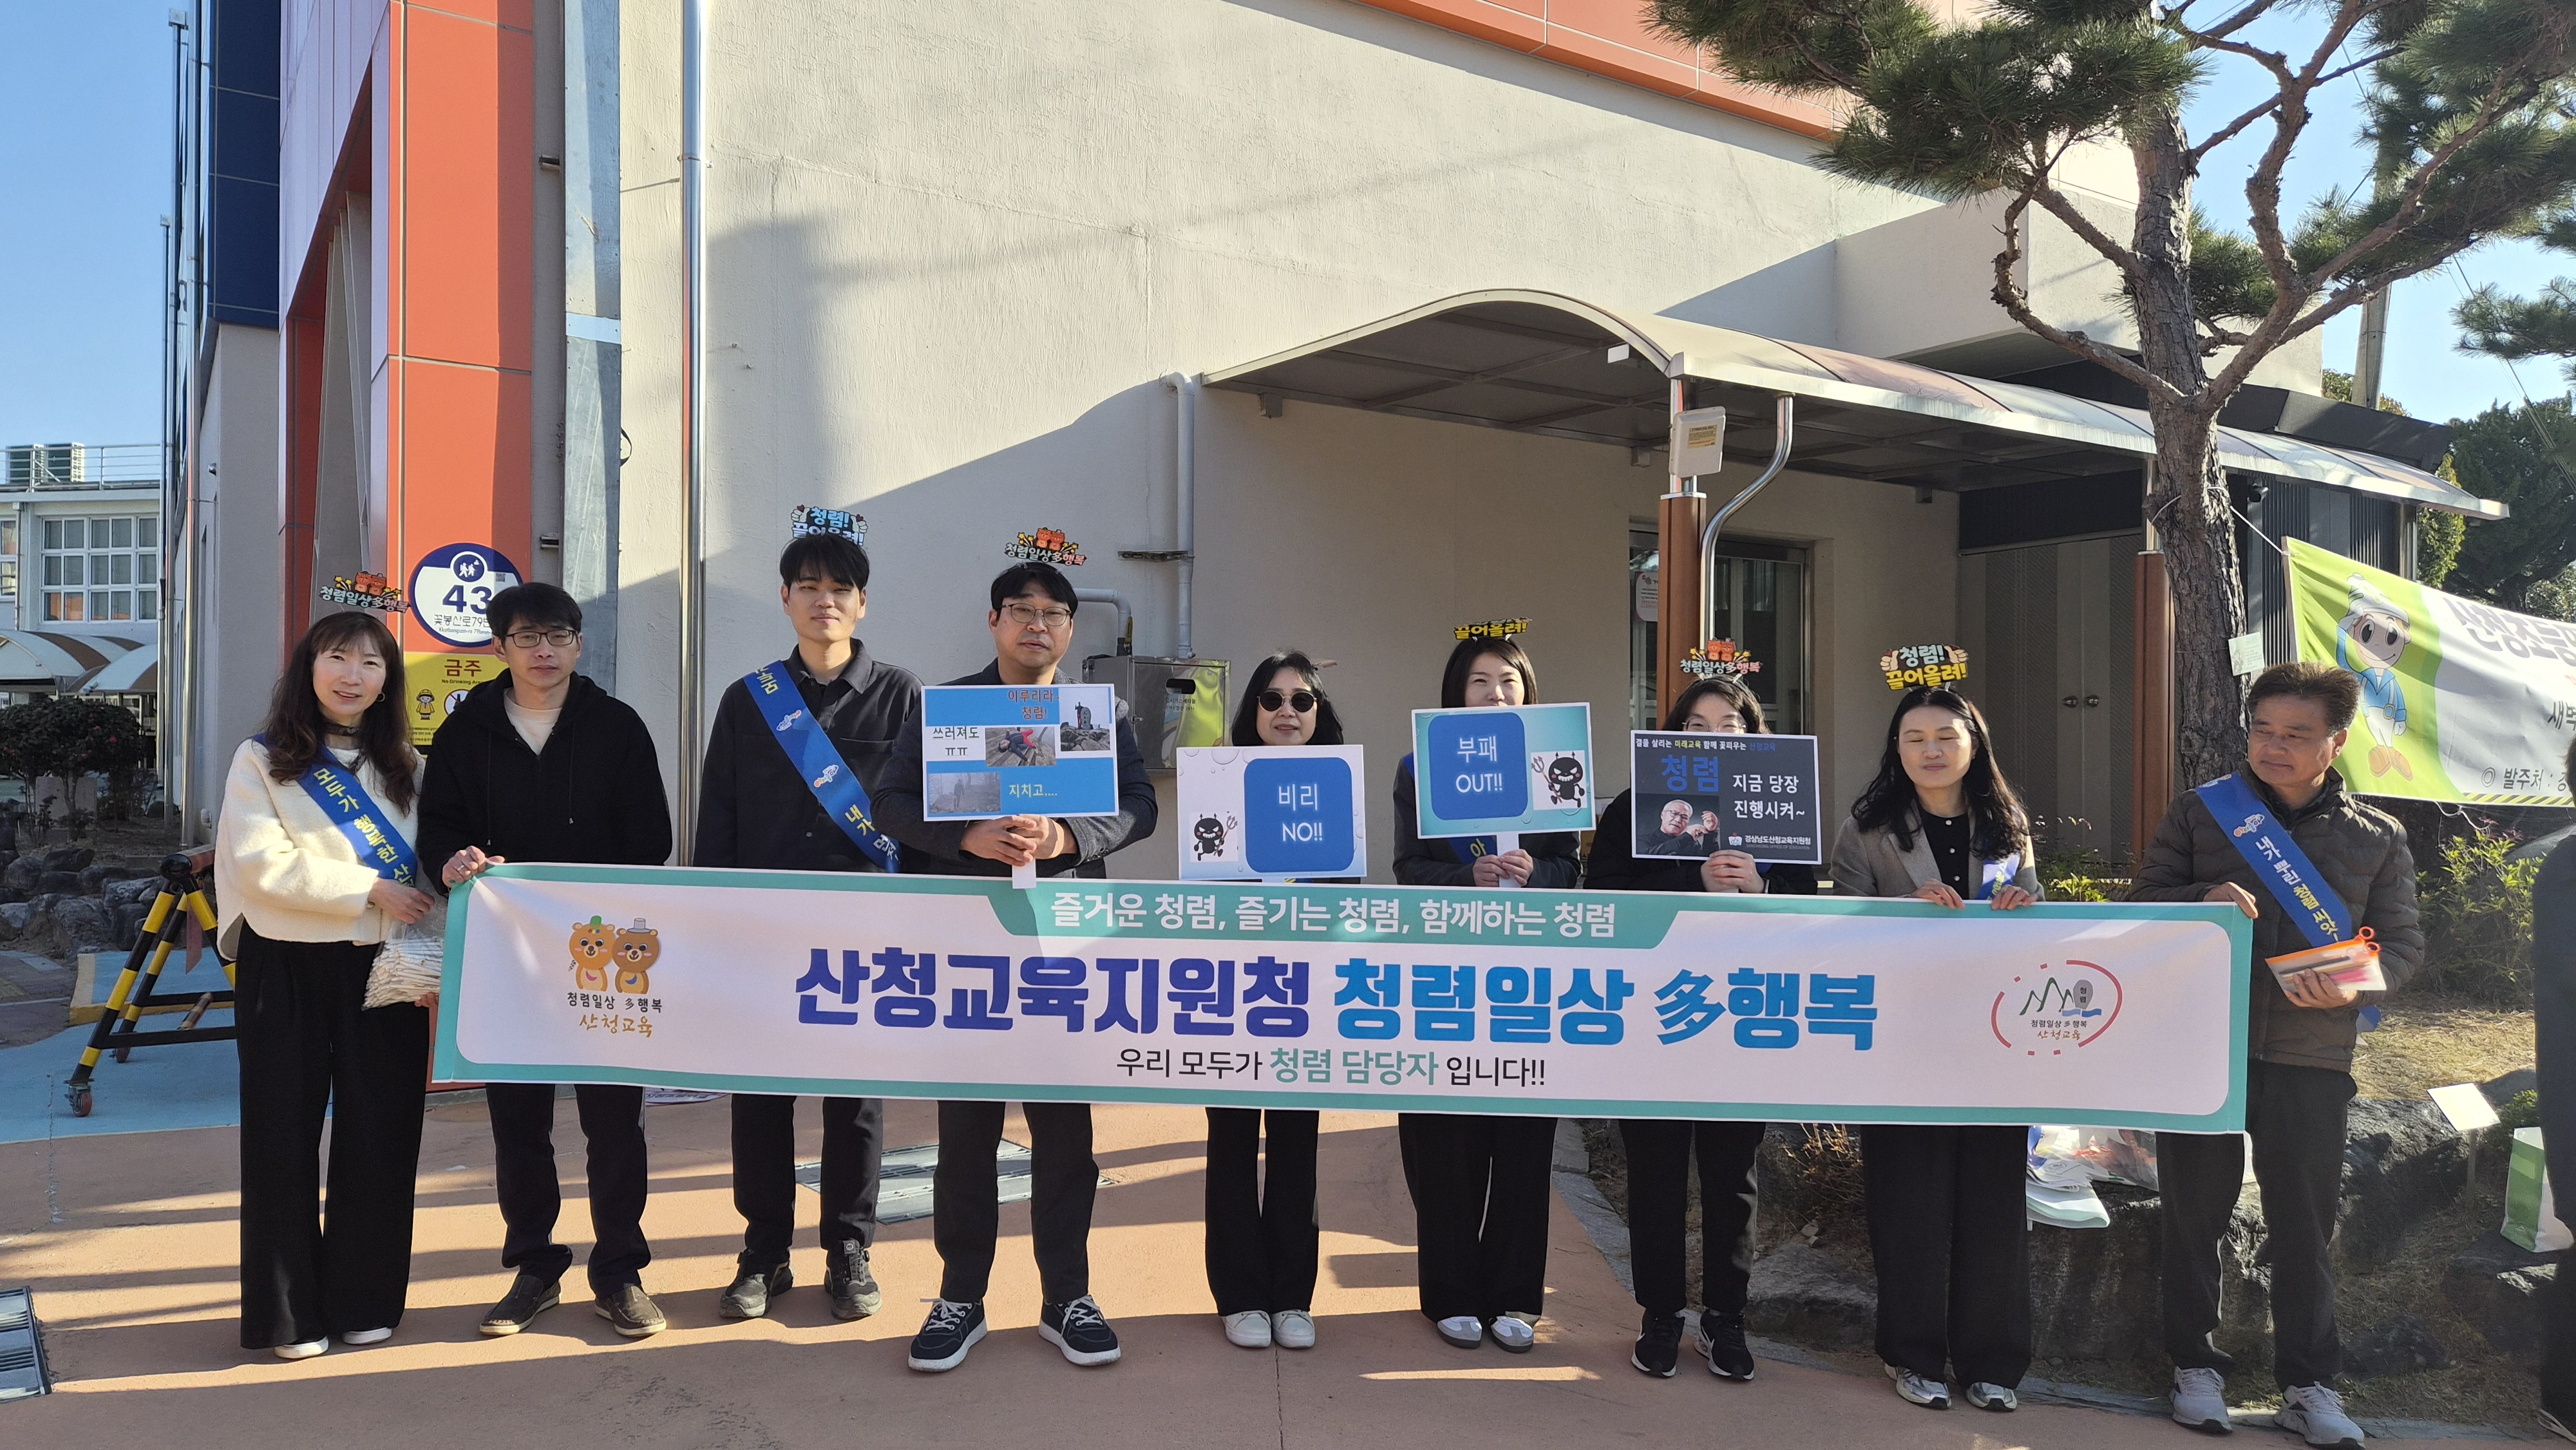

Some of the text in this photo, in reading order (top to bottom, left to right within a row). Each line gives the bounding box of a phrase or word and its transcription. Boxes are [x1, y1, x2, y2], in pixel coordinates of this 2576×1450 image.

[810, 506, 850, 528] 청렴!
[1005, 542, 1085, 566] 청렴일상多행복
[320, 586, 409, 612] 청렴일상多행복
[442, 584, 492, 615] 43
[1455, 623, 1527, 639] 끌어올려!
[1680, 659, 1760, 674] 청렴일상多행복
[1899, 645, 1945, 667] 청렴!
[444, 659, 482, 677] 금주
[1886, 663, 1967, 690] 끌어올려!
[1021, 706, 1047, 720] 청렴!
[933, 726, 980, 740] 쓰러져도
[1457, 735, 1498, 763] 부패
[1652, 739, 1672, 748] 살리는
[1674, 740, 1701, 749] 미래교육
[1703, 740, 1717, 749] 함께
[1719, 741, 1747, 751] 꽃피우는
[1456, 773, 1503, 793] OUT!!
[1661, 754, 1719, 793] 청렴
[1732, 774, 1799, 793] 지금 당장
[2503, 767, 2543, 791] 발주처
[313, 767, 360, 813] 모두가
[1278, 784, 1318, 811] 비리
[844, 804, 876, 836] 내가
[1734, 800, 1805, 820] 진행시켜~
[354, 813, 399, 864] 행복한
[1282, 822, 1323, 842] NO!!
[1745, 835, 1811, 845] 경상남도산청교육지원청
[2255, 836, 2282, 862] 내가
[2273, 860, 2302, 885] 뿌린
[2293, 883, 2320, 910] 청렴
[1051, 892, 1615, 938] 즐거운 청렴, 즐기는 청렴, 함께하는 청렴
[567, 992, 662, 1013] 청렴일상 多행복
[795, 946, 1879, 1051] 산청교육지원청 청렴일상 多행복
[579, 1013, 652, 1038] 산청교육
[2031, 1019, 2062, 1028] 청렴일상
[2038, 1029, 2081, 1040] 산청교육
[1117, 1047, 1546, 1087] 우리 모두가 청렴 담당자 입니다!!
